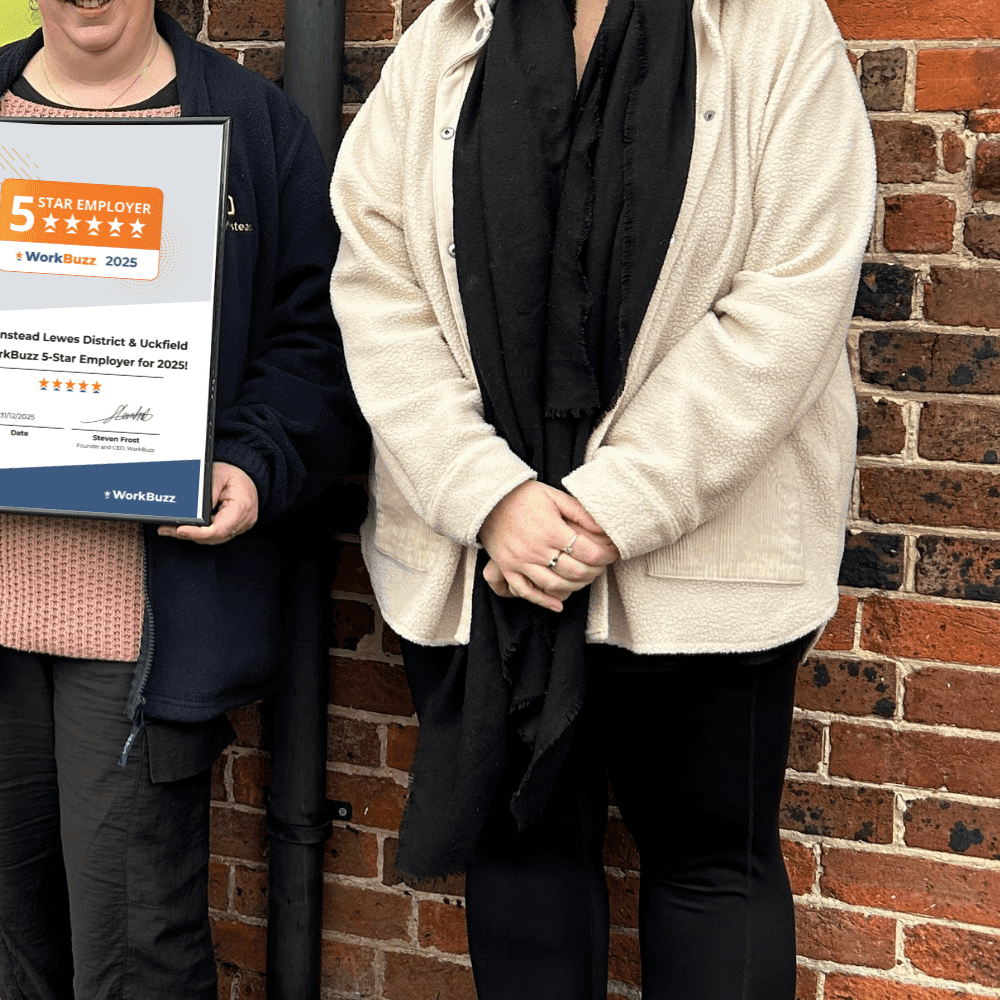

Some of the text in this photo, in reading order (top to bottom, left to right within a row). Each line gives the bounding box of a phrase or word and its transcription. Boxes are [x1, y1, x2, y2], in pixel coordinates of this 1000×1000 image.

[9, 195, 35, 232] 5
[38, 196, 152, 215] STAR EMPLOYER
[25, 251, 139, 268] WorkBuzz 2025
[43, 332, 80, 344] Lewes
[83, 335, 126, 347] District
[128, 338, 137, 348] &
[140, 338, 189, 351] Uckfield
[41, 352, 77, 364] 5-Star
[79, 354, 136, 368] Employer
[137, 357, 155, 368] for
[157, 359, 189, 370] 2025!
[0, 412, 36, 420] 31/12/2025
[10, 429, 29, 437] Date
[92, 434, 140, 444] Steven Frost
[76, 442, 100, 450] Founder
[112, 489, 177, 504] WorkBuzz
